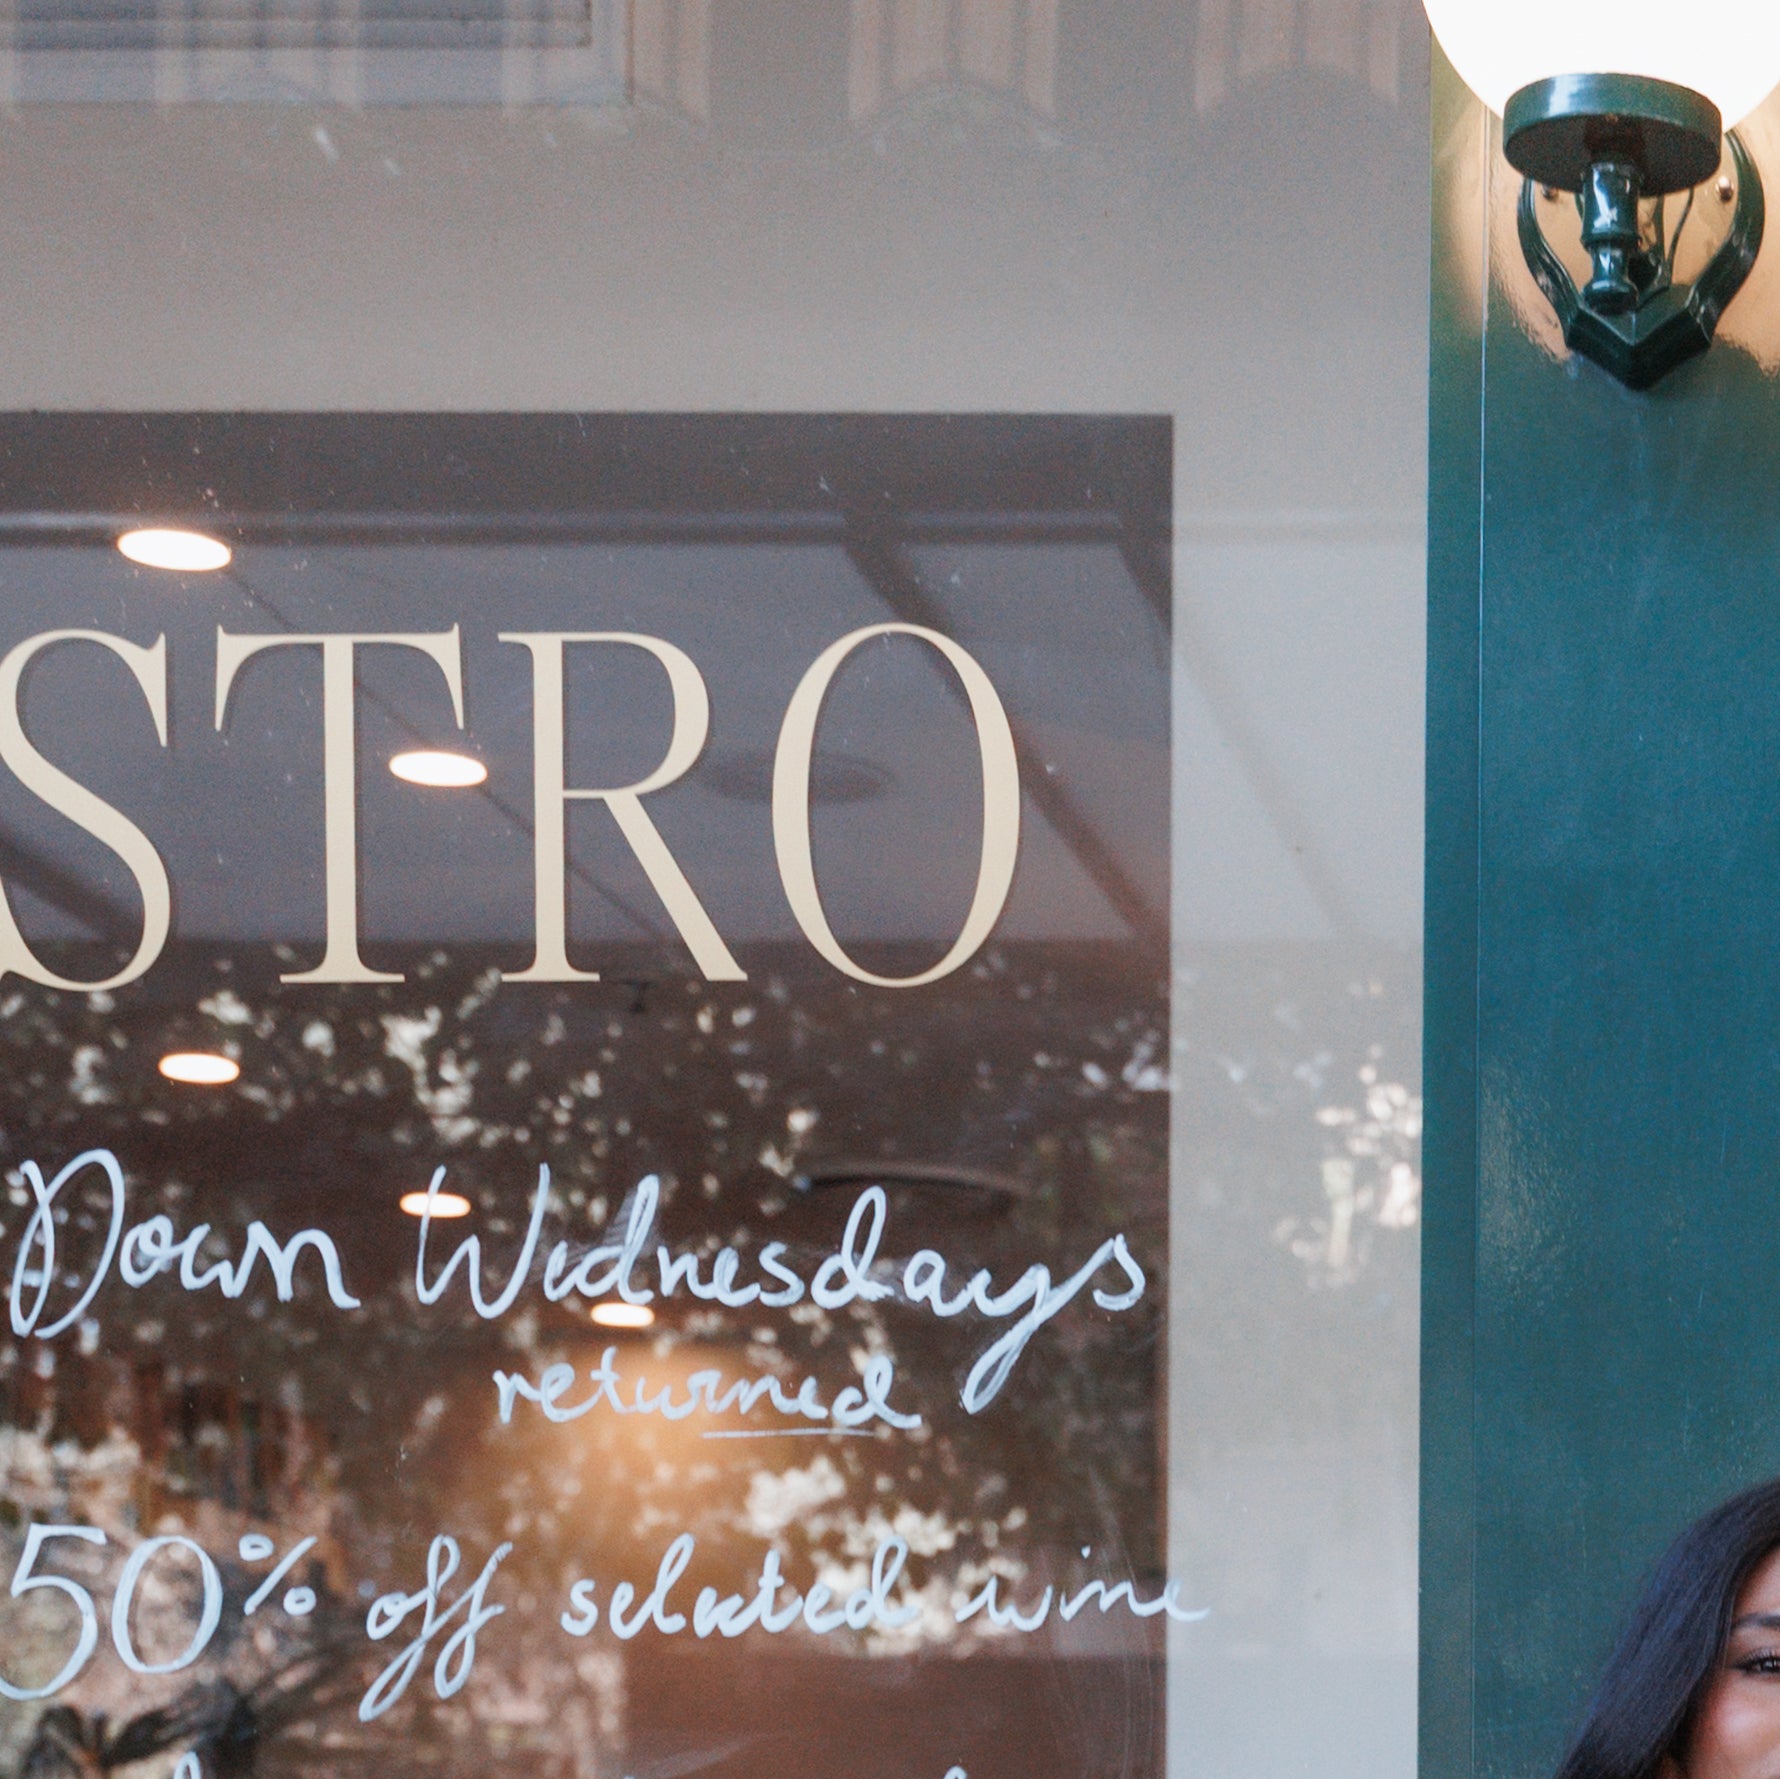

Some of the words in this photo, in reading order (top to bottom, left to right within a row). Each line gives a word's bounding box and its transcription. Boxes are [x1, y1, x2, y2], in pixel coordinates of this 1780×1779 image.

[0, 622, 1021, 991] STRO
[0, 1524, 317, 1700] 50%
[358, 1534, 514, 1721] off
[561, 1533, 918, 1639] selected
[955, 1546, 1211, 1632] wine
